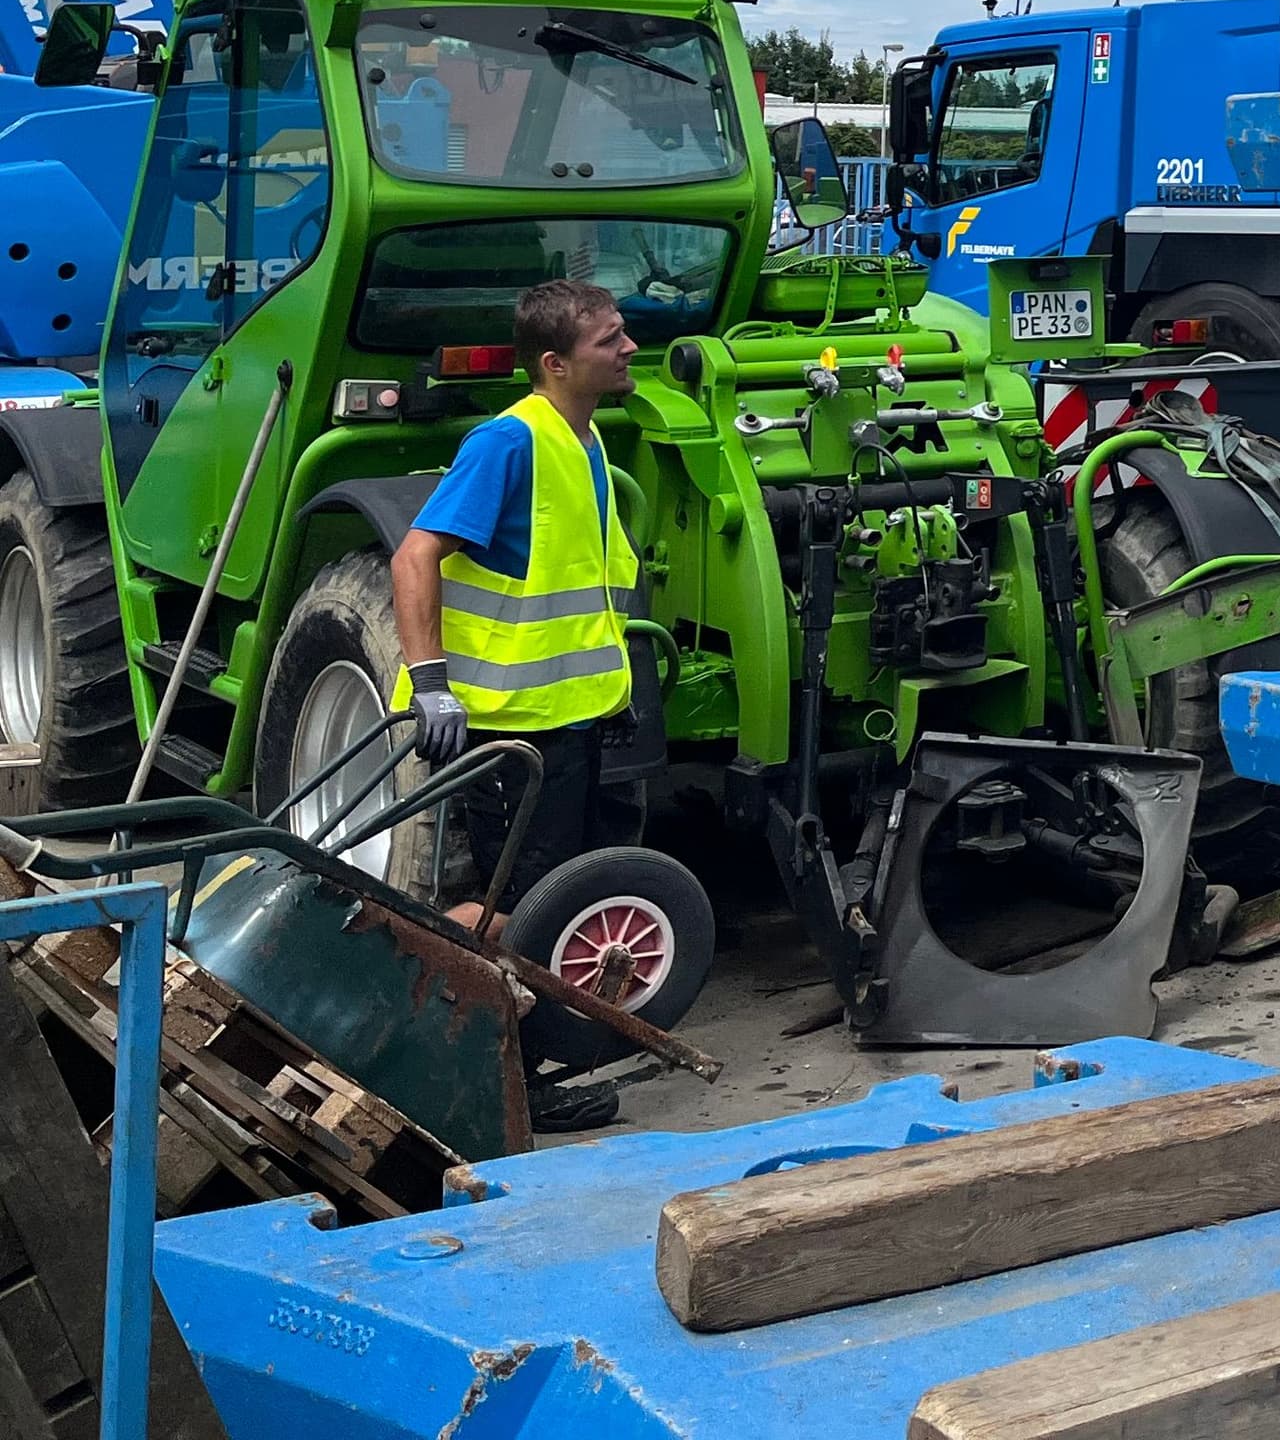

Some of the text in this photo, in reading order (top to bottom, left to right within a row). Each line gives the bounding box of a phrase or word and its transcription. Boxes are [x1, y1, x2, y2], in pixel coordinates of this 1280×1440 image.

[1157, 158, 1204, 184] 2201
[1157, 184, 1241, 202] LIEBHERR
[960, 244, 1015, 256] FELBERMAYR
[1027, 294, 1066, 313] PAN
[1017, 315, 1071, 336] PE 33
